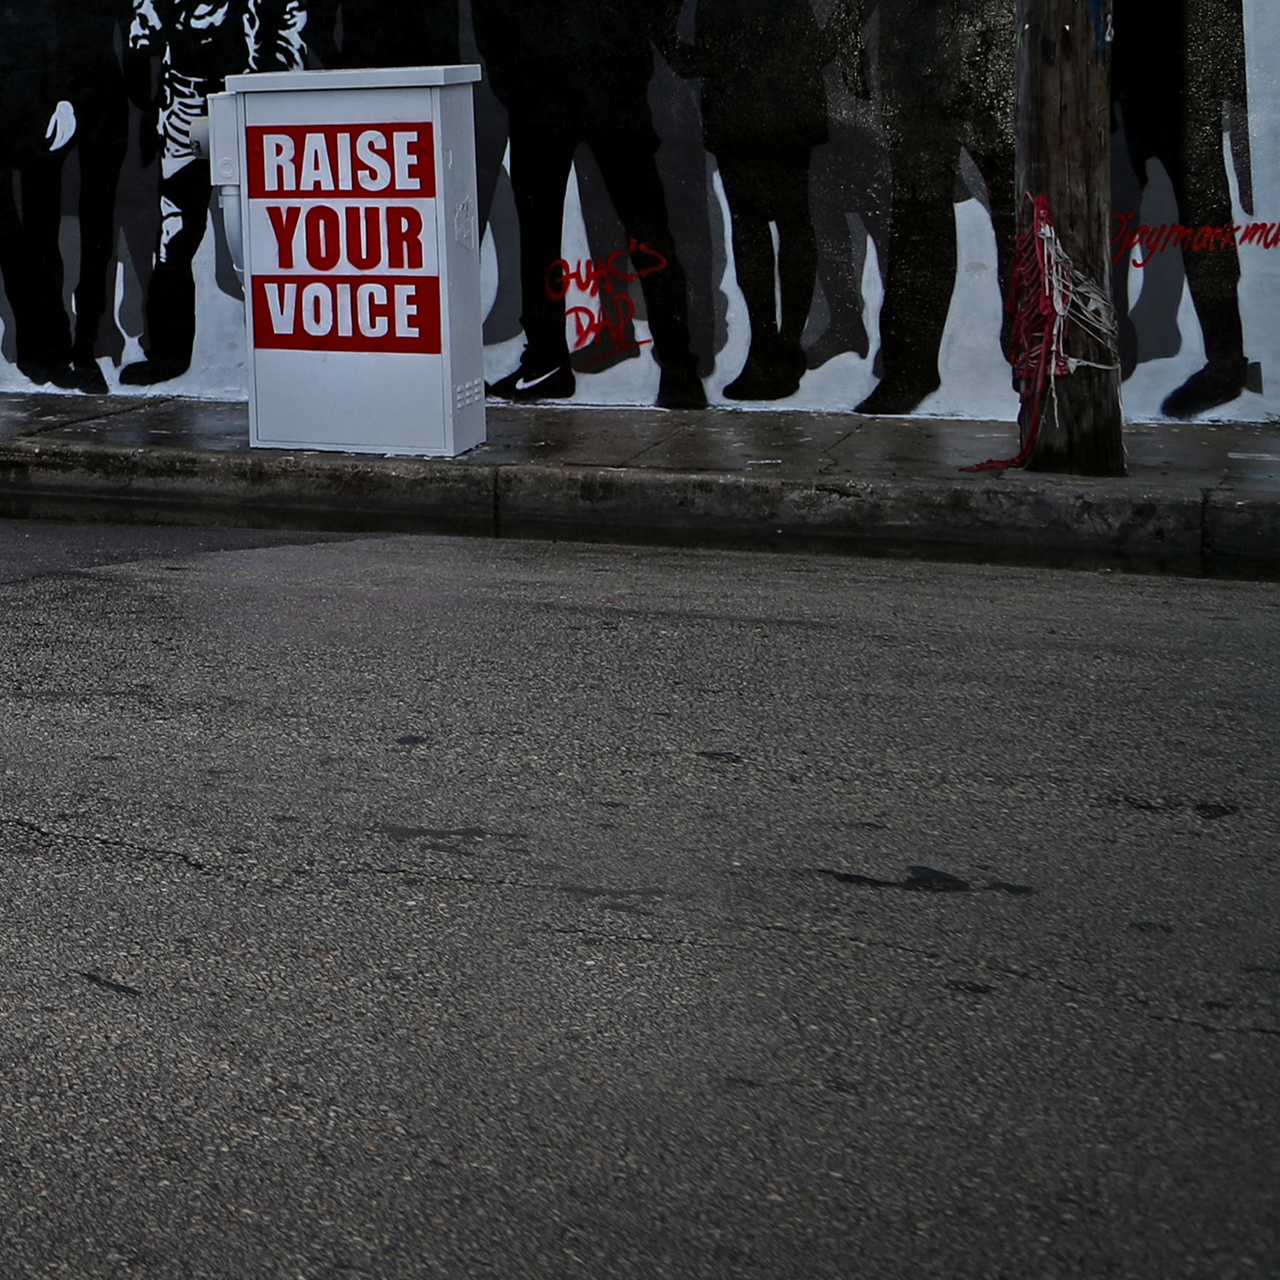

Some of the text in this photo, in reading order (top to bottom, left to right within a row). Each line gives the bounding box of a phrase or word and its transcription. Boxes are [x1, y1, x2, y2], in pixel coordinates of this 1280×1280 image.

[262, 130, 421, 191] RAISE
[265, 204, 423, 271] YOUR
[263, 282, 420, 338] VOICE
